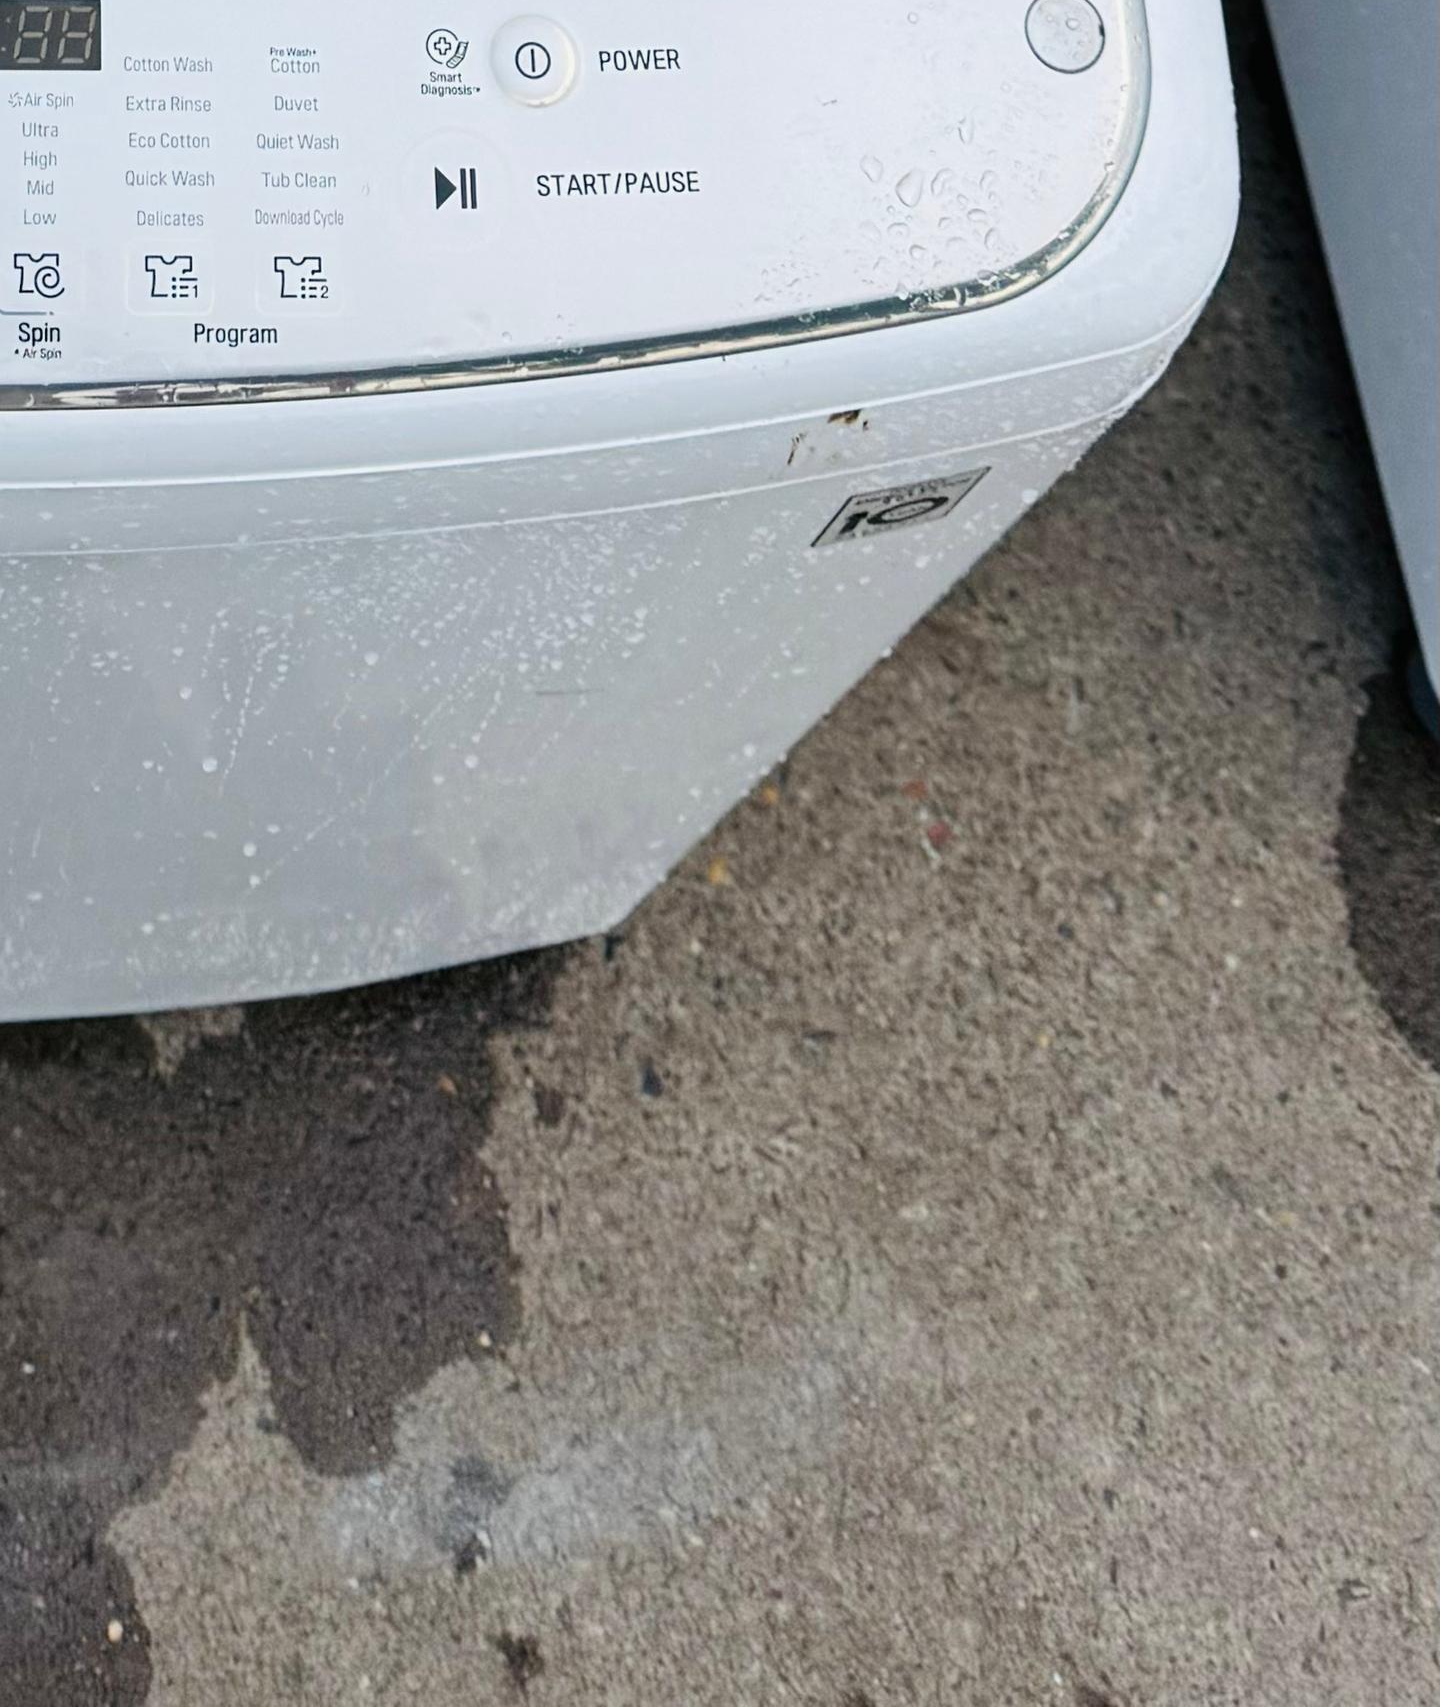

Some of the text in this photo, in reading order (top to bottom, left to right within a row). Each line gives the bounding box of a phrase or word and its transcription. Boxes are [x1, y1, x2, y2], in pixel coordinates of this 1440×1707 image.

[269, 46, 285, 57] Pre
[598, 48, 681, 72] POWER
[123, 55, 213, 73] Cotton Wash
[270, 57, 321, 74] Cotton
[429, 71, 463, 83] Smart
[23, 92, 74, 110] Air Spin
[125, 95, 212, 113] Extra Rinse
[274, 95, 319, 112] Duvet
[22, 122, 59, 138] Ultra
[128, 132, 210, 149] Eco Cotton
[256, 133, 340, 150] Quiet Wash
[23, 150, 58, 171] High
[125, 170, 215, 187] Quick Wash
[261, 171, 337, 188] Tub Clean
[536, 170, 700, 197] START/PAUSE
[26, 179, 54, 196] Mid
[23, 209, 57, 226] Low
[136, 210, 204, 227] Delicates
[254, 208, 344, 228] Download Cycle
[18, 322, 61, 347] Spin
[194, 322, 278, 348] Program
